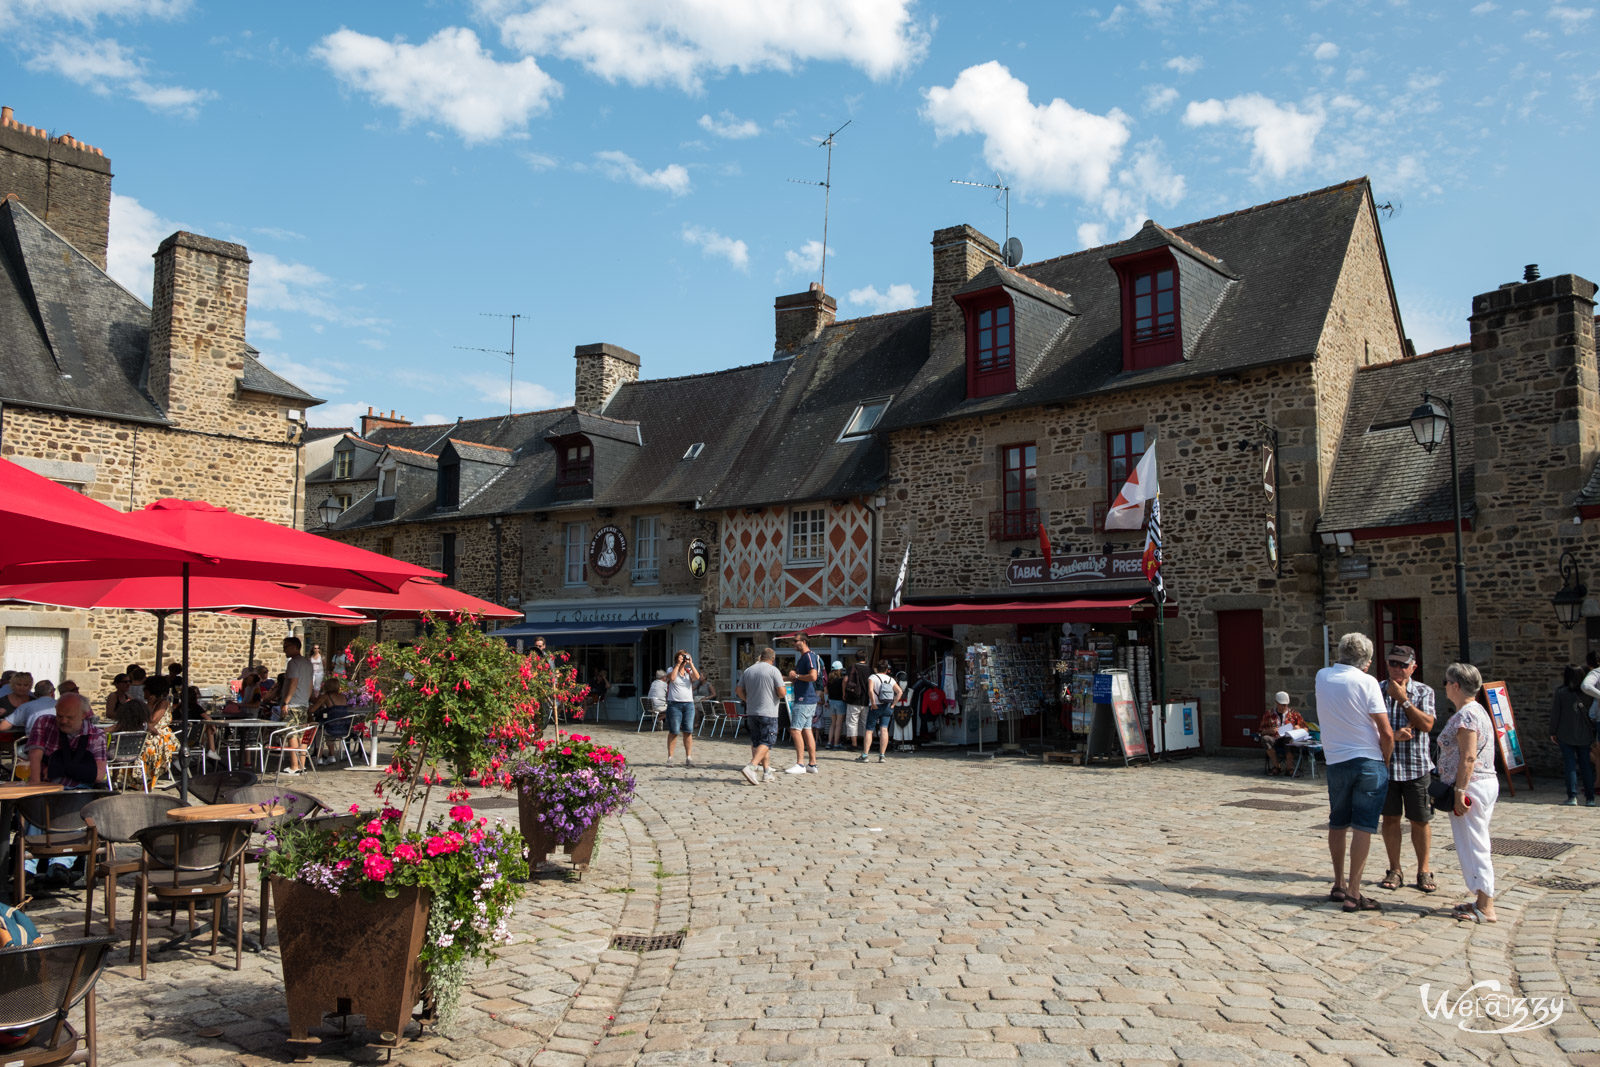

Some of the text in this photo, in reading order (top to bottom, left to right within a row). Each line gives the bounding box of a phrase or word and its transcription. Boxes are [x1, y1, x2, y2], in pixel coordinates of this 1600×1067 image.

[618, 532, 626, 552] GRILL
[1012, 556, 1143, 580] TABAC Souvenirs PRESS
[553, 608, 660, 623] La Duchesse Anne
[772, 622, 787, 630] La
